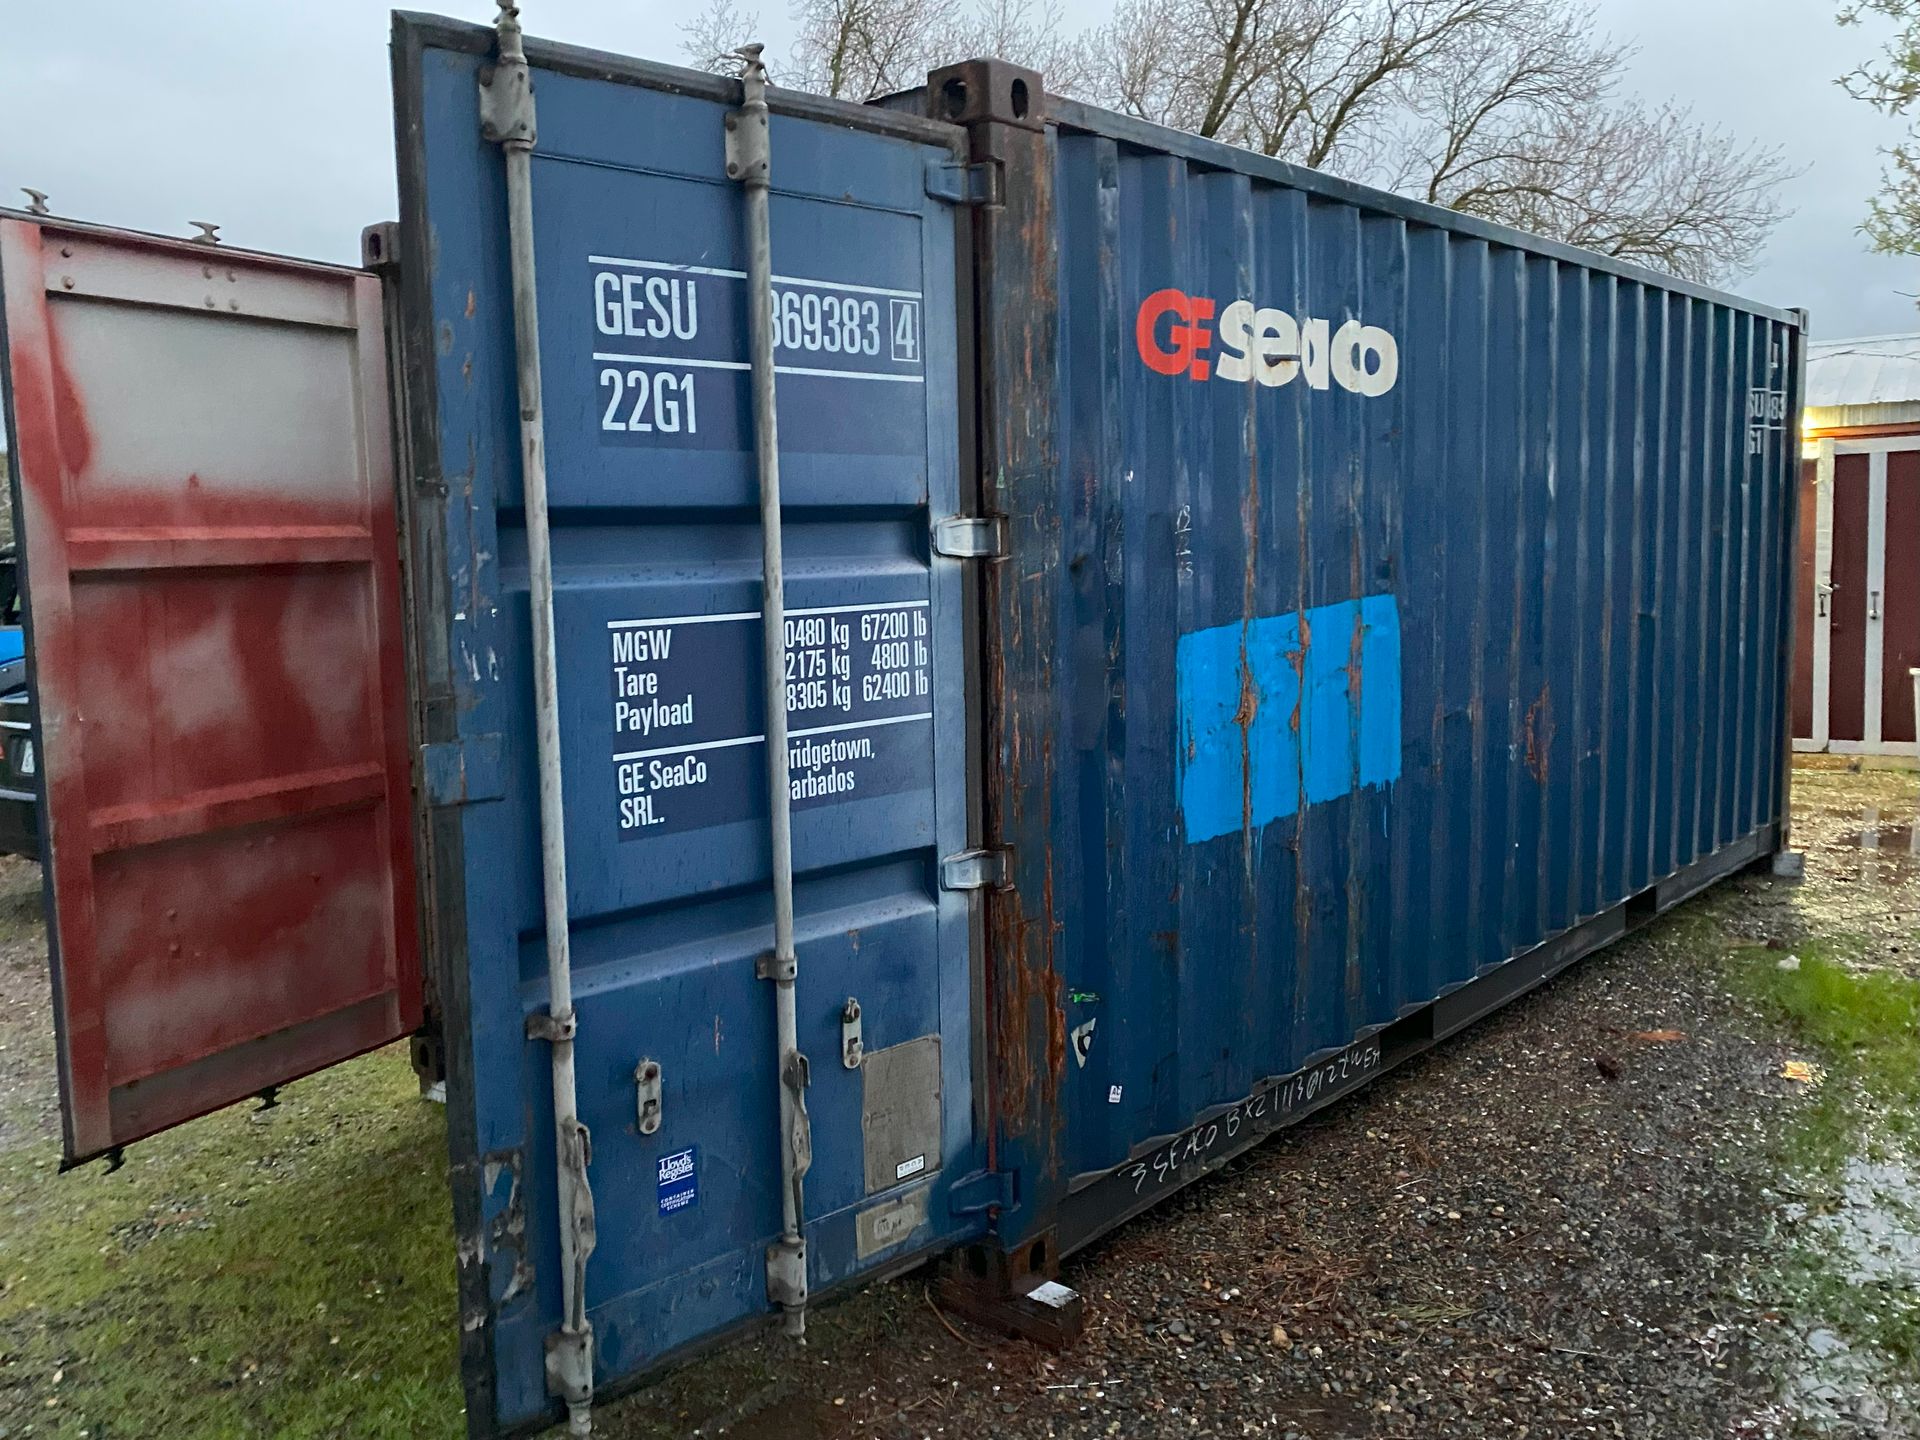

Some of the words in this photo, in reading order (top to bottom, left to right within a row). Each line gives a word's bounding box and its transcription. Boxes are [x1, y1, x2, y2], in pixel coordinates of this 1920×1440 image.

[595, 271, 697, 340] GESU
[895, 303, 915, 358] 4
[1136, 288, 1215, 381] GE
[600, 368, 697, 434] 22G1
[613, 629, 672, 664] MGW
[784, 617, 826, 648] 0480
[831, 616, 850, 650] kg
[861, 611, 909, 642] 67200
[913, 610, 927, 638] lb
[614, 666, 658, 697] Tare
[785, 649, 826, 680] 2175
[831, 649, 851, 681] kg
[871, 642, 909, 671] 4800
[914, 641, 928, 667] lb
[615, 694, 693, 735] Payload
[786, 680, 828, 712] 8305
[832, 680, 851, 712] kg
[862, 671, 911, 702] 62400
[915, 671, 929, 697] lb
[618, 762, 645, 796] GE
[650, 754, 707, 791] SeaCo
[787, 737, 876, 774] ridgetown,
[620, 795, 665, 829] SRL.
[787, 769, 855, 801] arbados
[659, 1162, 694, 1181] Register
[660, 1153, 692, 1171] Lloyd's
